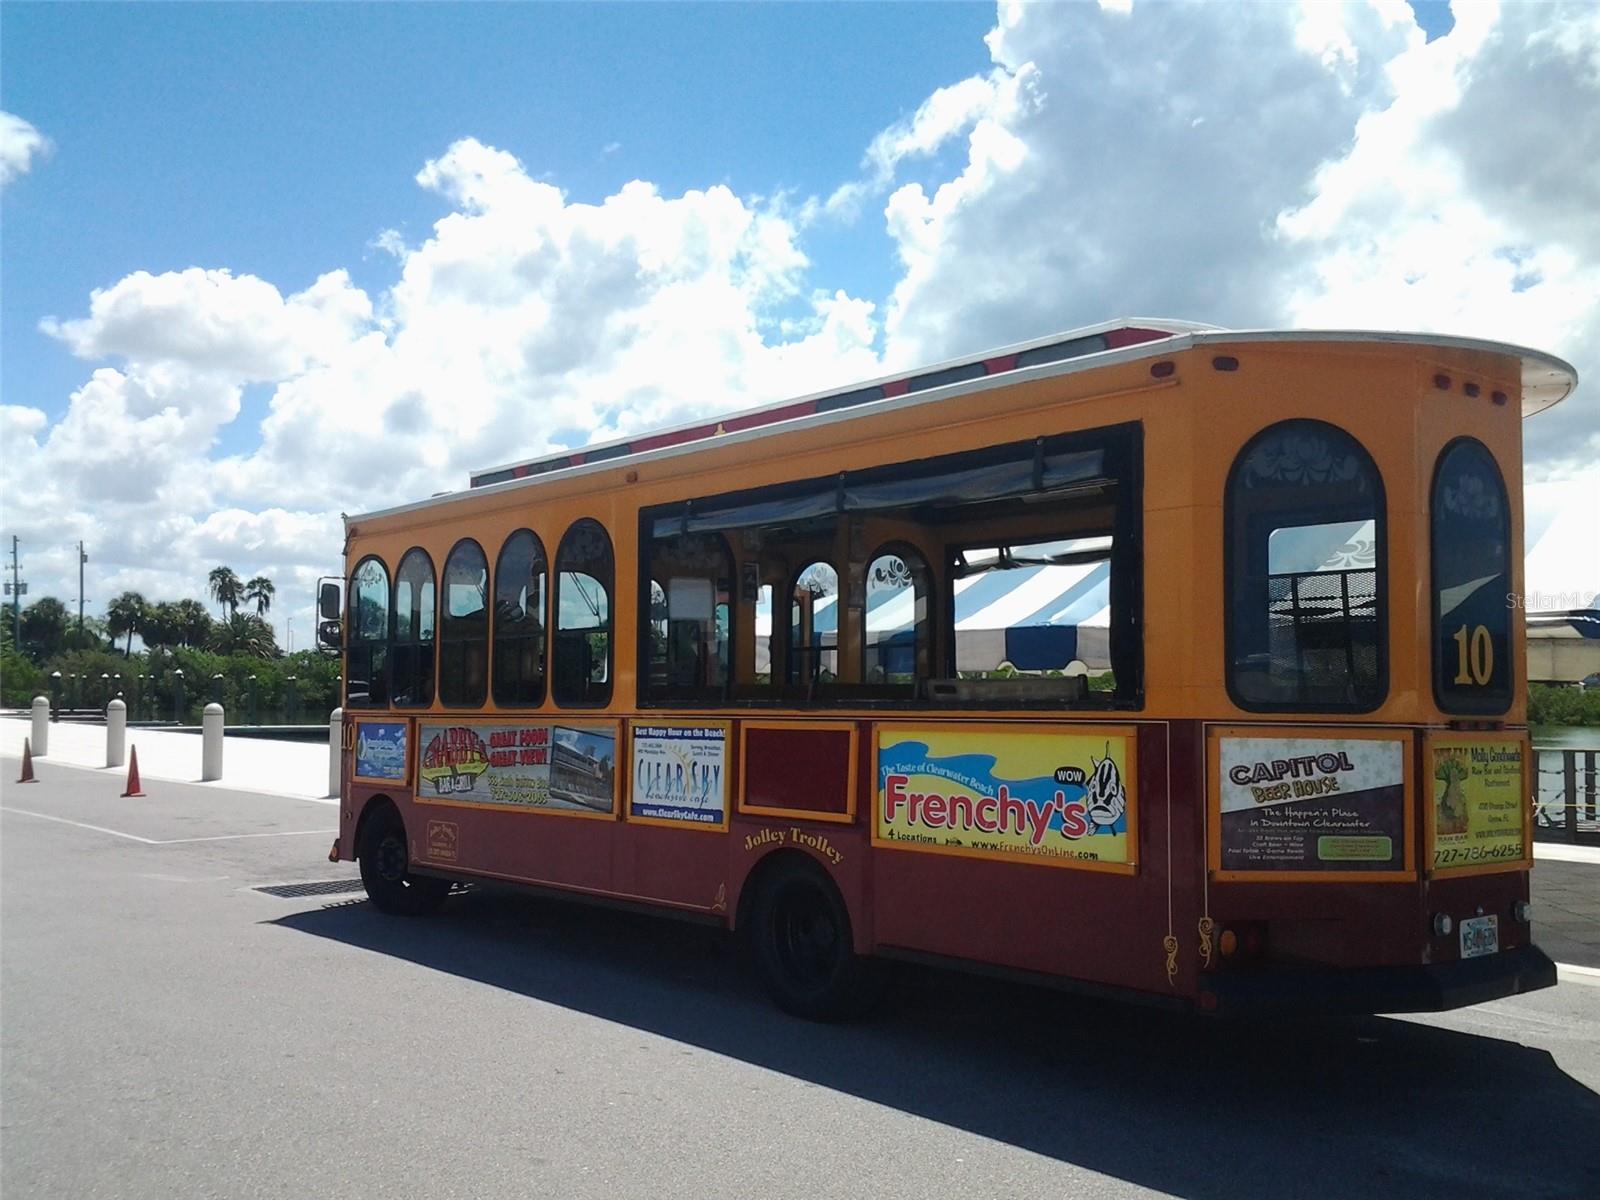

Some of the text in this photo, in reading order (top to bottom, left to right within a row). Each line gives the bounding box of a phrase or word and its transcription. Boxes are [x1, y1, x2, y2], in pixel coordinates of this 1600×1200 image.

[1453, 624, 1493, 686] 10
[341, 723, 354, 750] 10
[490, 728, 548, 748] GREAT FOOD!
[635, 727, 648, 736] Best
[648, 728, 667, 737] Happy
[667, 728, 682, 736] Hour
[693, 729, 703, 737] the
[704, 729, 725, 738] Beach!
[490, 748, 547, 768] GREAT VIEW!
[1229, 751, 1355, 785] CAPITOL
[638, 758, 720, 796] CLEAR SKY
[880, 761, 995, 796] The Taste of Clearwater Beach
[1057, 769, 1083, 783] WOW
[1250, 776, 1340, 803] BEER HOUSE
[642, 808, 714, 823] www.ClearSkyCafe.com
[885, 773, 1089, 846] Frenchy's
[1263, 807, 1282, 817] The
[1331, 807, 1360, 818] Place
[1261, 818, 1311, 829] Downtown
[1313, 818, 1371, 829] Clearwater
[744, 826, 844, 865] Jolley Trolley
[888, 828, 895, 840] 4
[897, 831, 937, 844] Locations
[1433, 844, 1522, 864] 727-786-6255
